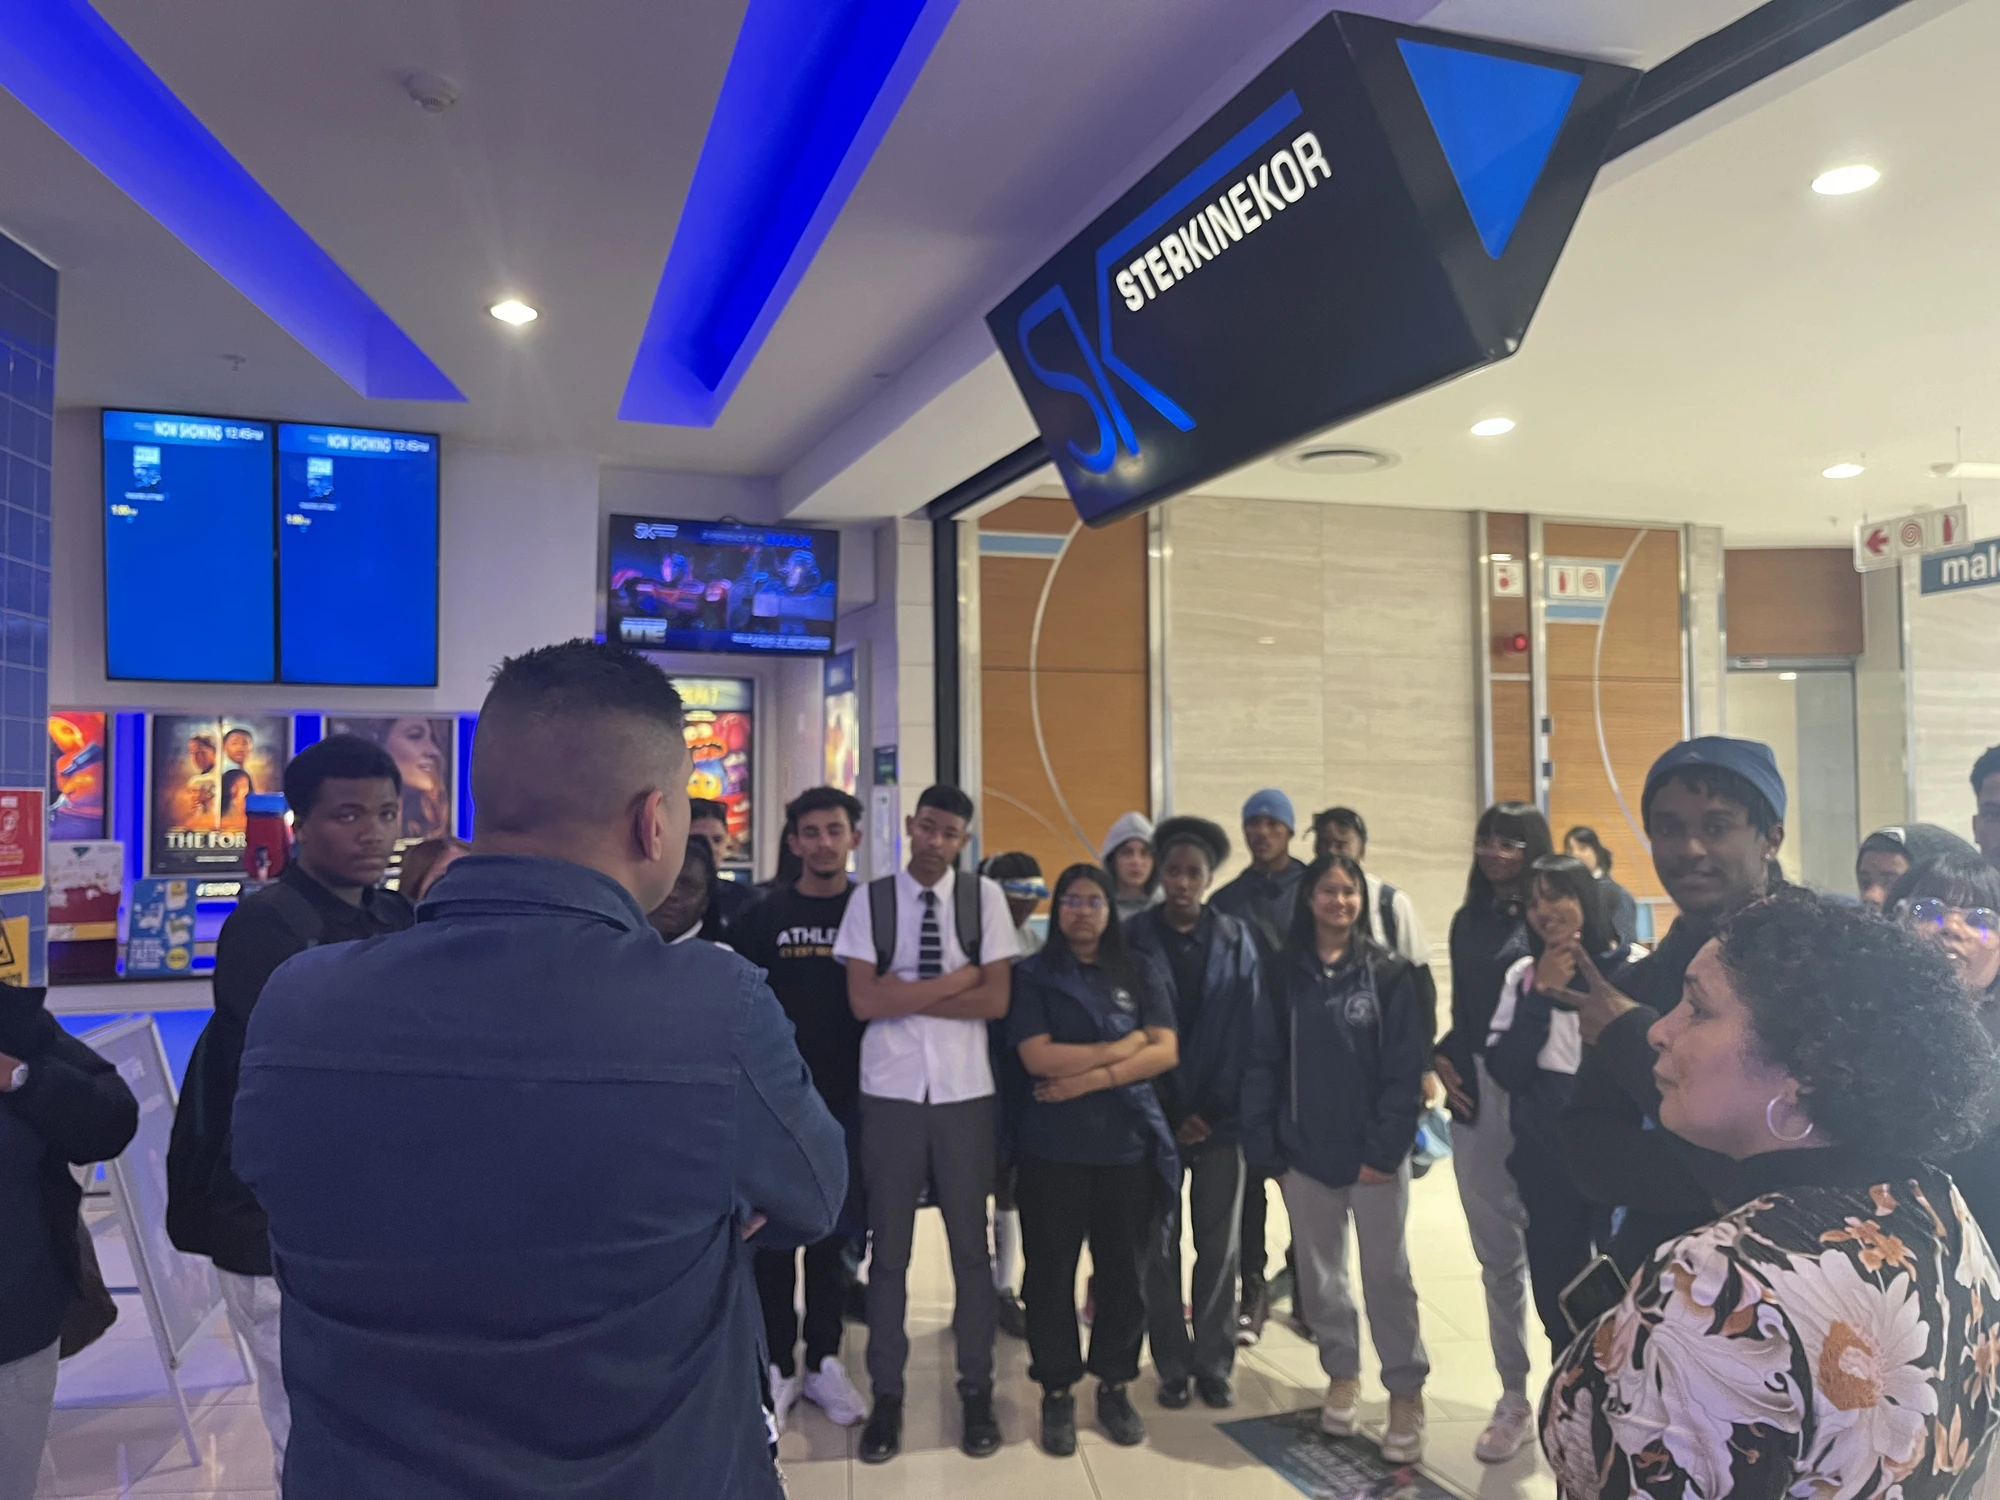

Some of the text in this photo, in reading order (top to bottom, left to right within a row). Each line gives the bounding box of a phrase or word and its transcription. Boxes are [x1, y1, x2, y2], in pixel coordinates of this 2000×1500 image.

[1115, 130, 1332, 312] STERKINEKOR
[154, 420, 178, 437] NOW
[179, 422, 223, 441] SHOWING
[327, 433, 349, 449] NOW
[350, 434, 391, 453] SHOWING
[1941, 543, 2000, 586] mal
[165, 830, 247, 849] THE FOR
[776, 926, 838, 948] ATHLE
